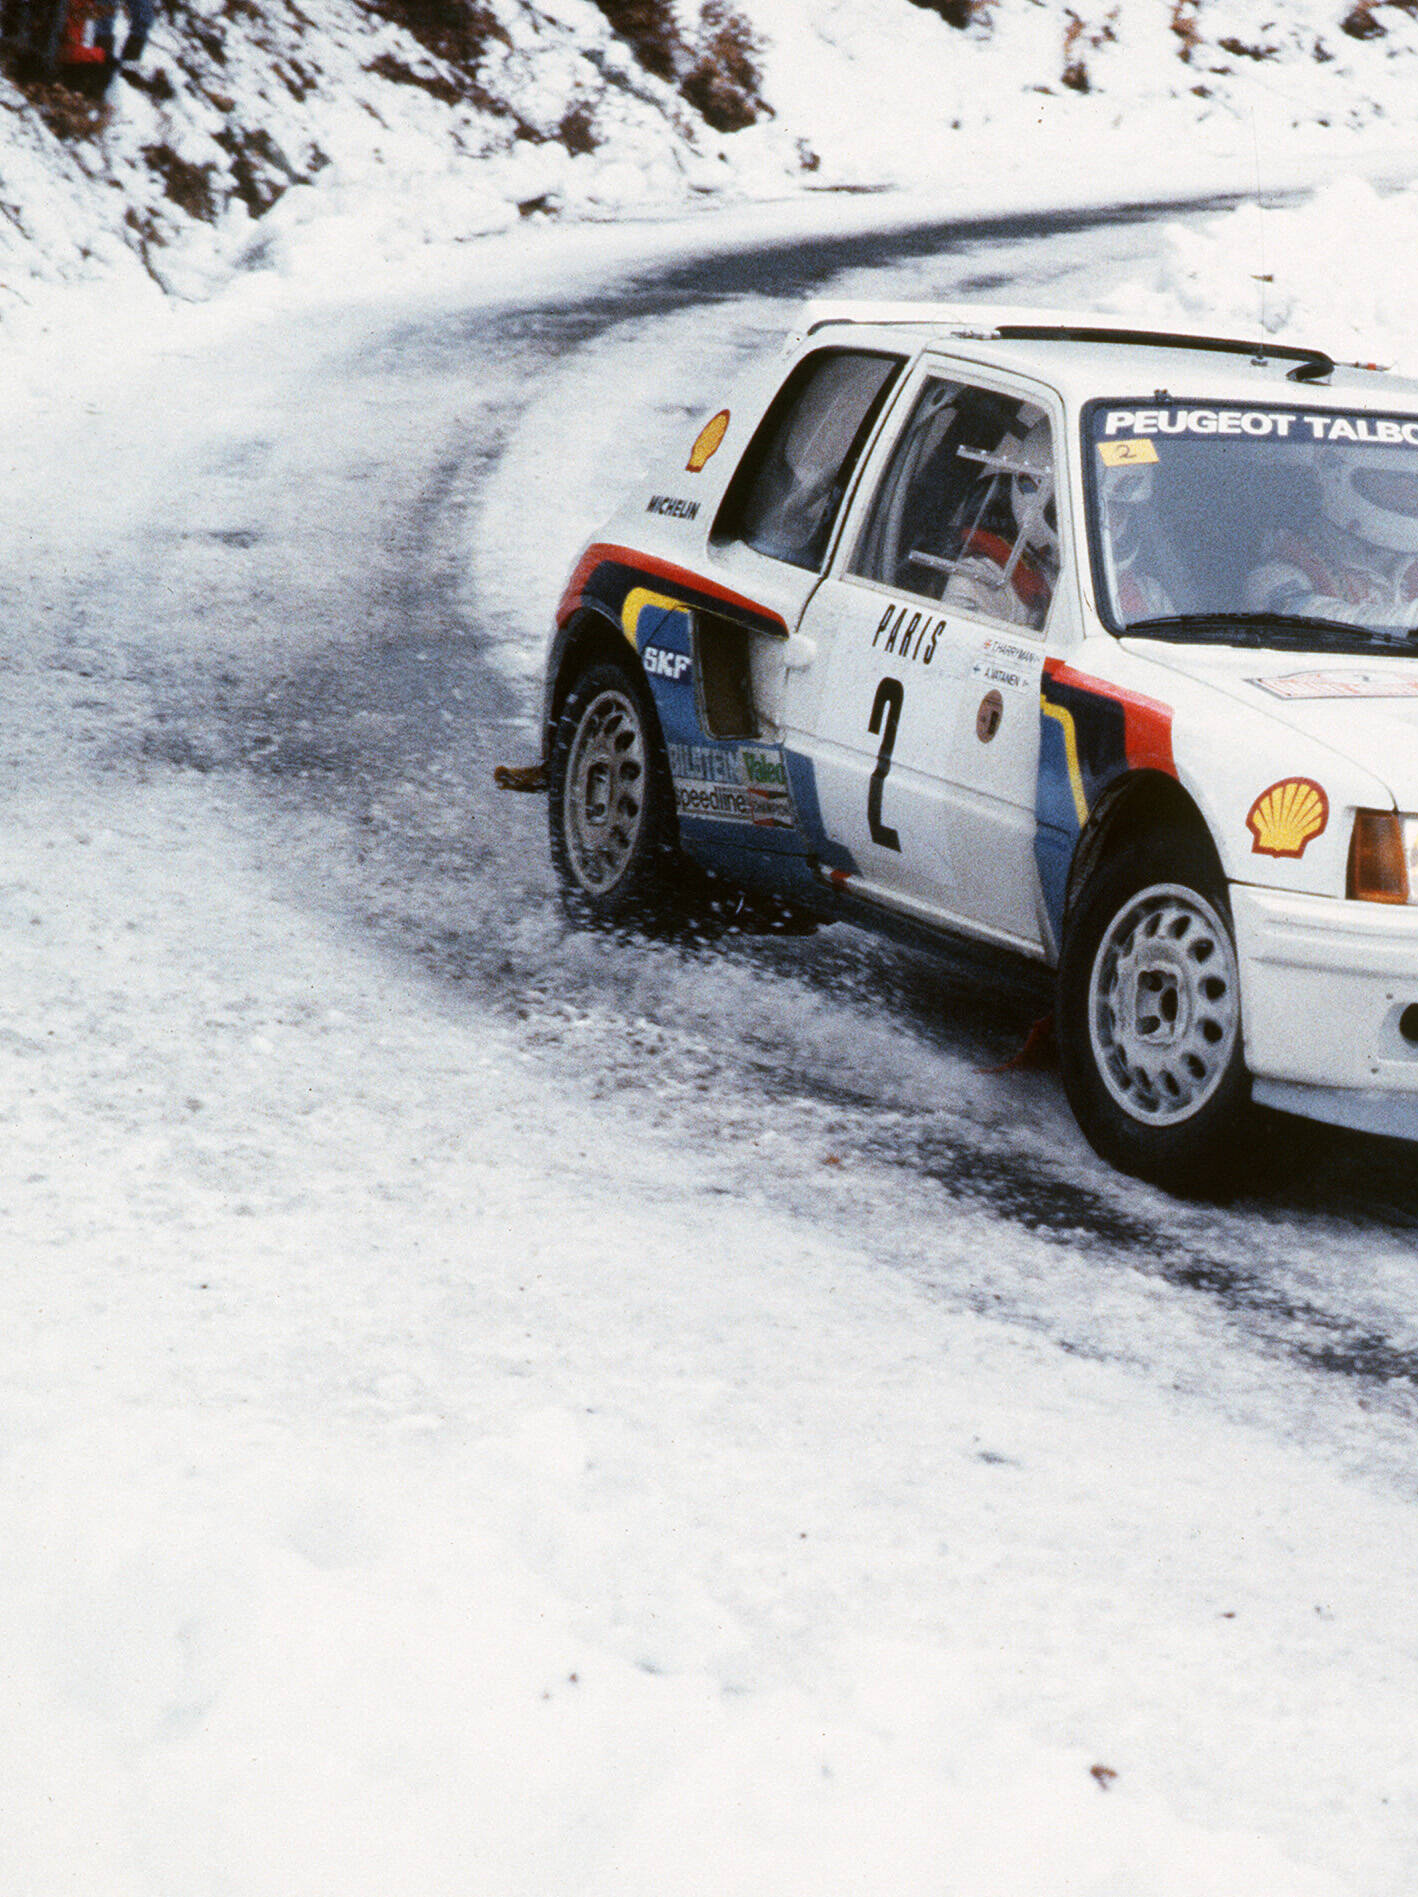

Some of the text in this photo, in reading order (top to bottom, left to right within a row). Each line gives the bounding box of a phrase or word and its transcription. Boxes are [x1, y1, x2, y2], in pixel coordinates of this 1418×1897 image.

[1105, 410, 1296, 436] PEUGEOT
[1115, 444, 1137, 459] 2
[645, 495, 701, 520] MICHELIN
[871, 604, 947, 665] PARIS
[643, 646, 692, 679] SKF
[742, 752, 785, 785] Valeo
[867, 677, 904, 853] 2
